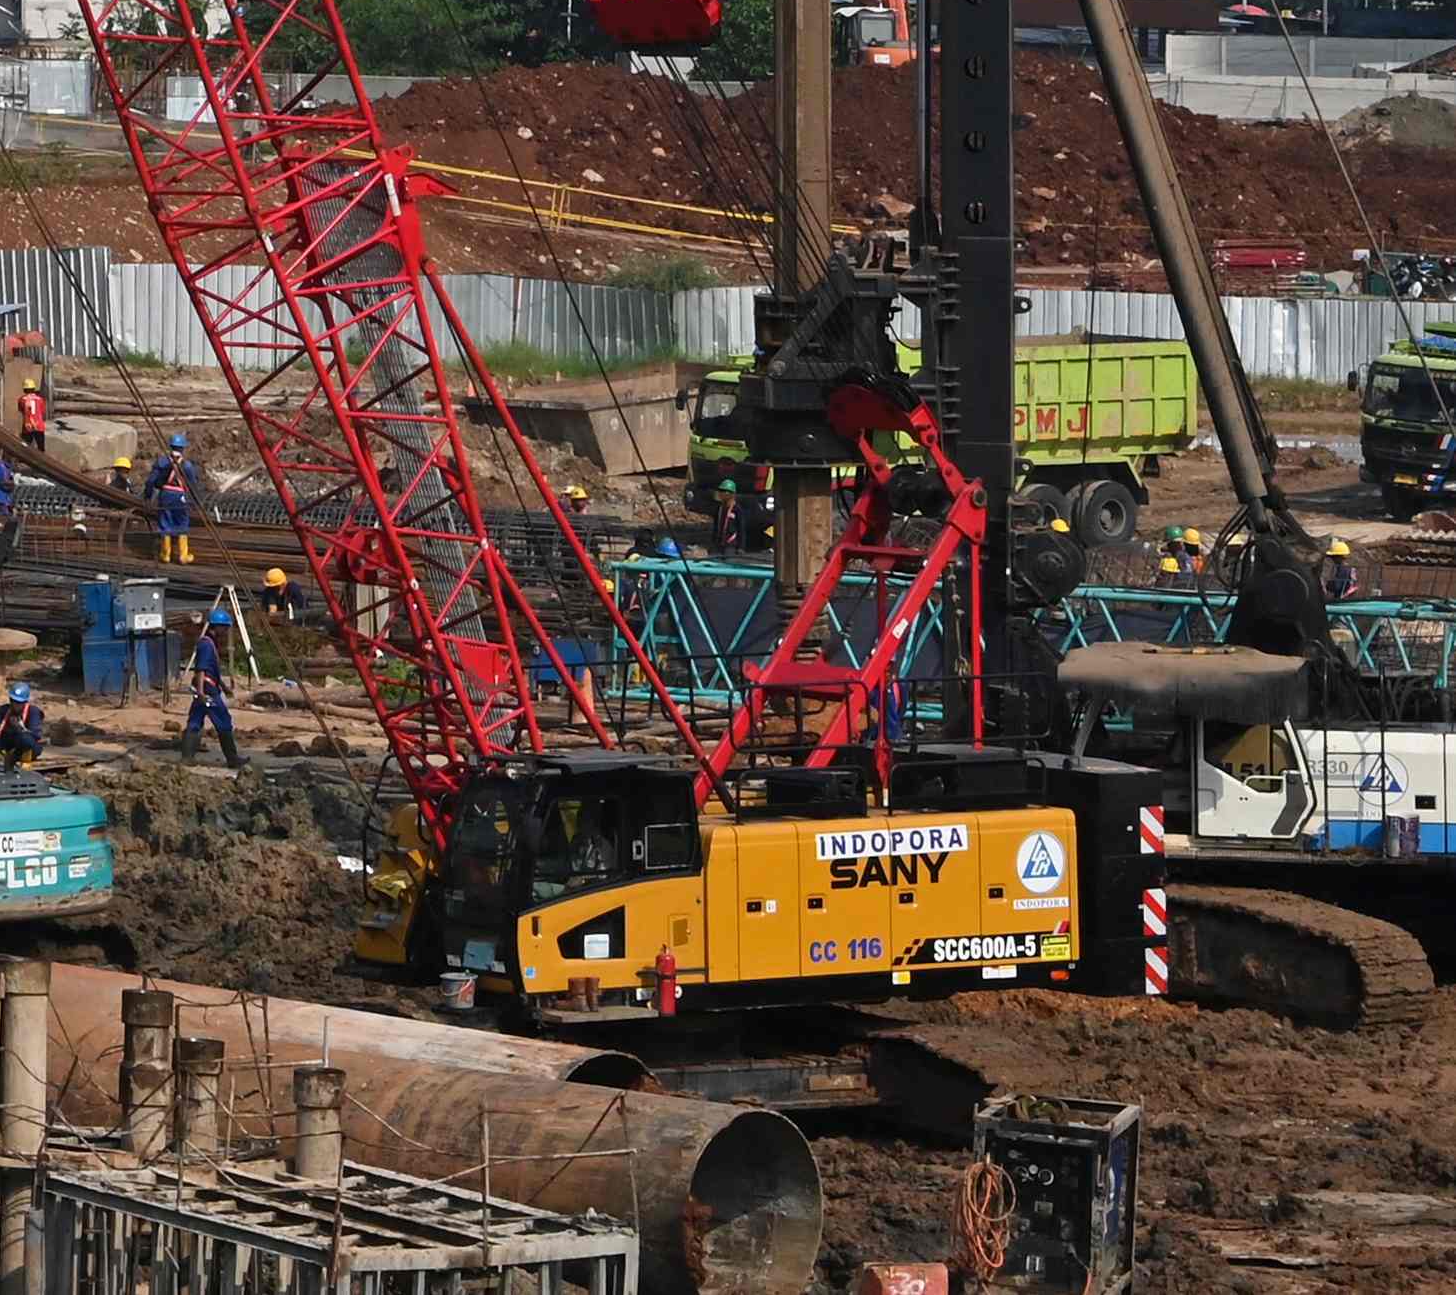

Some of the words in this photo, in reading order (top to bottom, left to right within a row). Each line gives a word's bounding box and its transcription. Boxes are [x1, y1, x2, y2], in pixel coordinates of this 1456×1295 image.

[819, 827, 964, 857] INDOPORA
[830, 851, 950, 890] SANY
[1015, 898, 1068, 909] INDOPORA
[809, 940, 837, 962] CC
[847, 937, 882, 959] 116
[933, 935, 1037, 962] SCC600A-5
